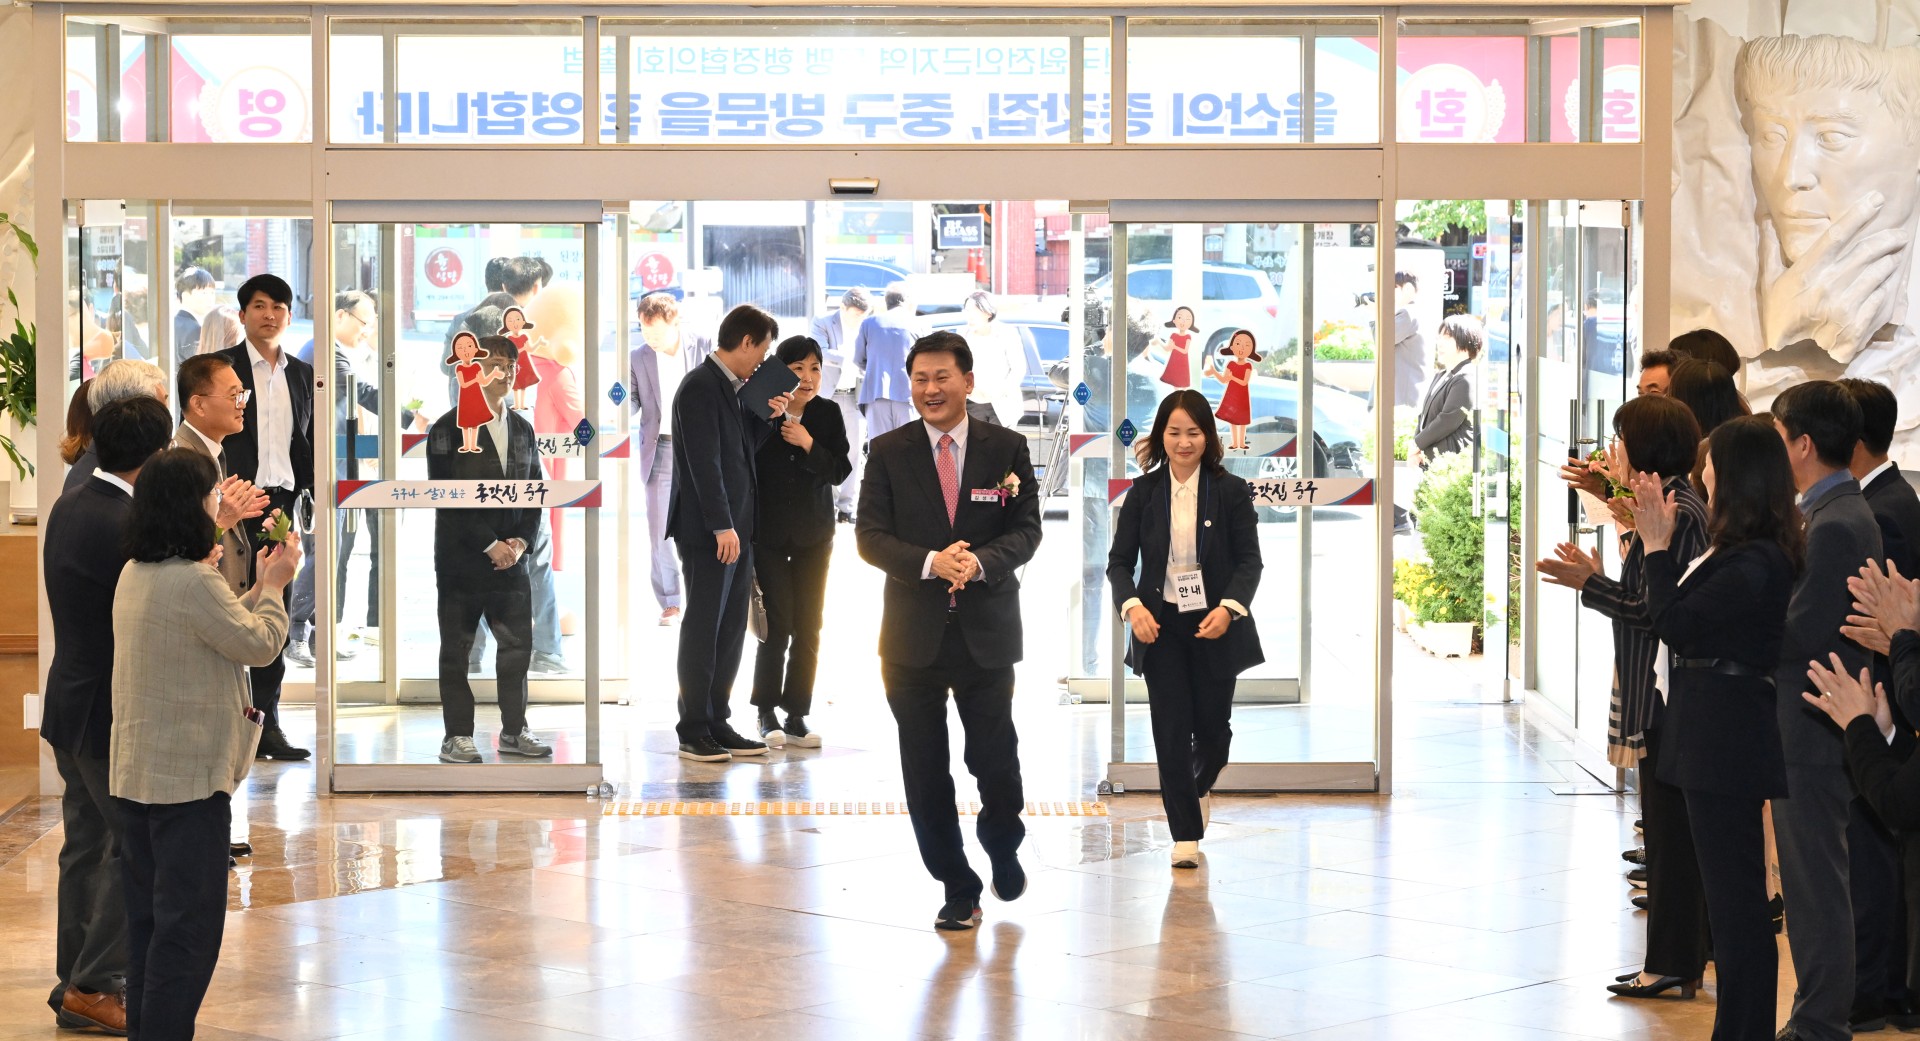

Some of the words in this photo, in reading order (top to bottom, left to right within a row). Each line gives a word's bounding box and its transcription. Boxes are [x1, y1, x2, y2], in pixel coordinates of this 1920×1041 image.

[391, 487, 421, 501] 누구나
[423, 486, 446, 501] 살고
[448, 488, 467, 500] 싶은
[474, 482, 518, 505] 종갓집
[523, 481, 549, 505] 중구
[1292, 480, 1318, 504] 중구
[1178, 584, 1202, 598] 안내
